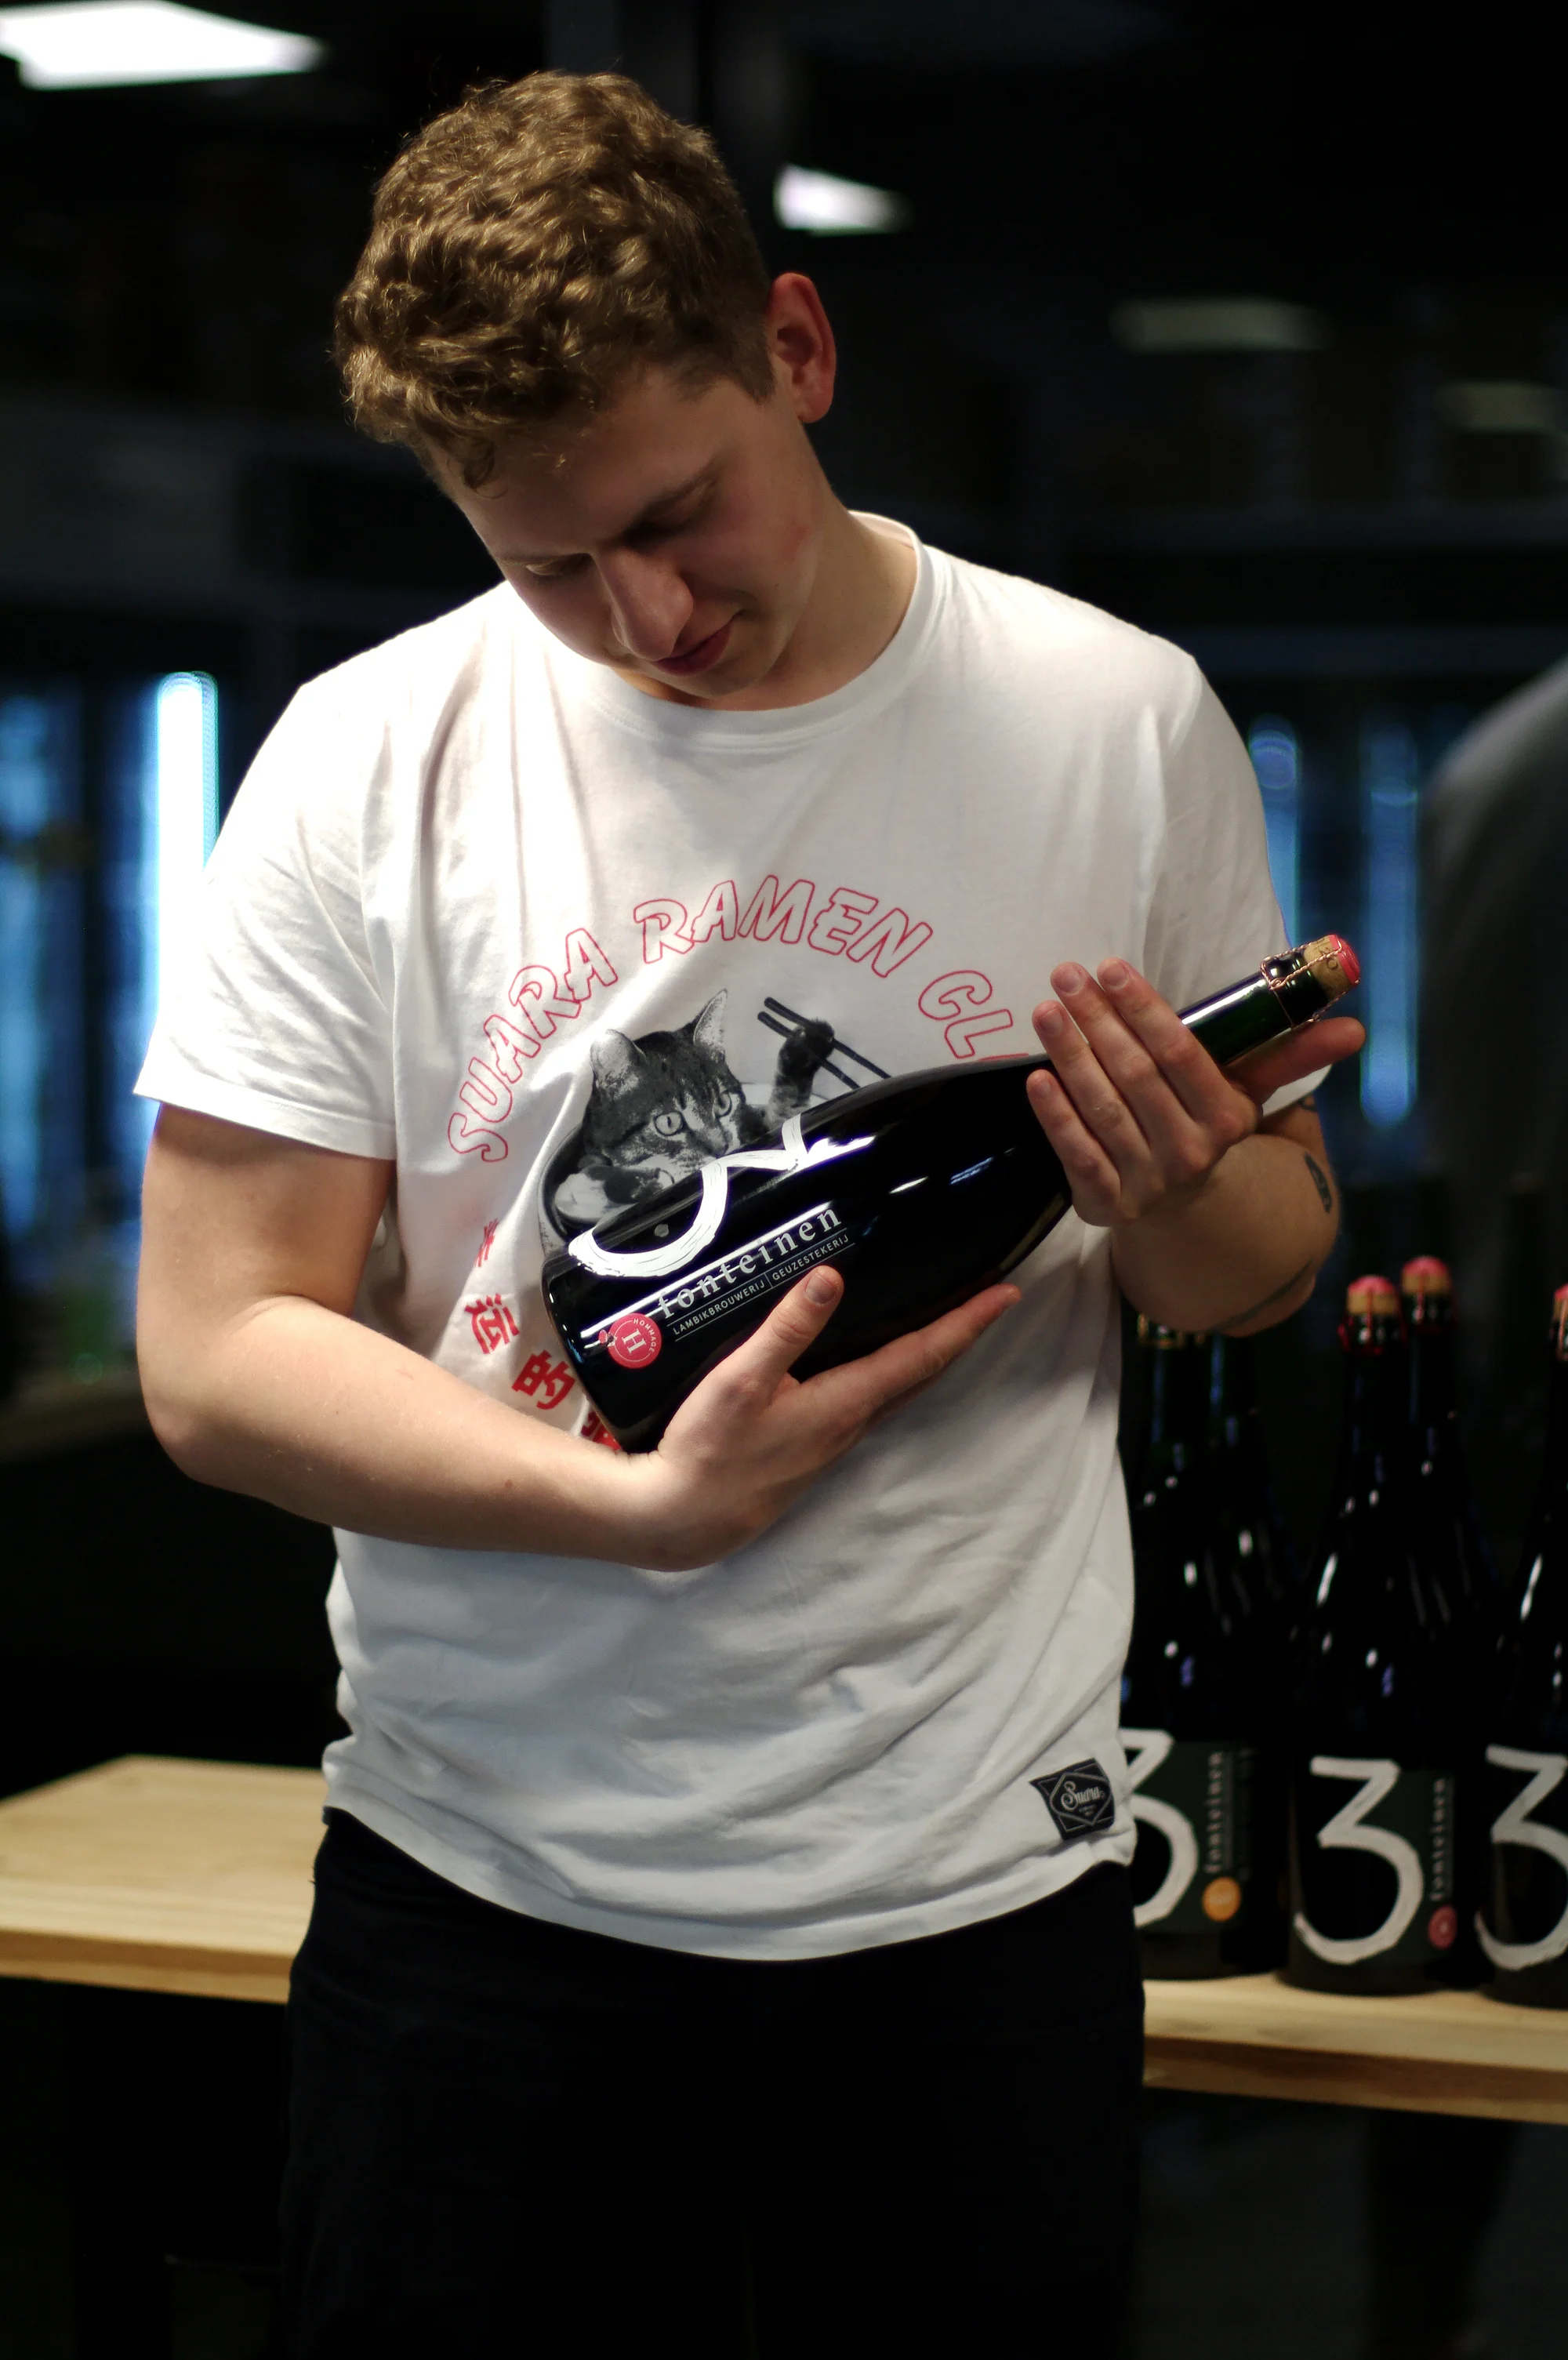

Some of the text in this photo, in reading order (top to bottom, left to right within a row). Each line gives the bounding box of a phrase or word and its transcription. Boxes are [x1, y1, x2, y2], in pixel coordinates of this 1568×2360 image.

[448, 874, 1029, 1163] SUARA RAMEN CL
[658, 1207, 842, 1320] fonteinen
[673, 1234, 850, 1335] LAMBIKBROUWERIJ GEUZESTEKERIJ
[621, 1328, 647, 1354] H
[633, 1317, 657, 1352] HOMMAGE
[1293, 1754, 1425, 1966] 3
[1473, 1741, 1568, 1971] 3
